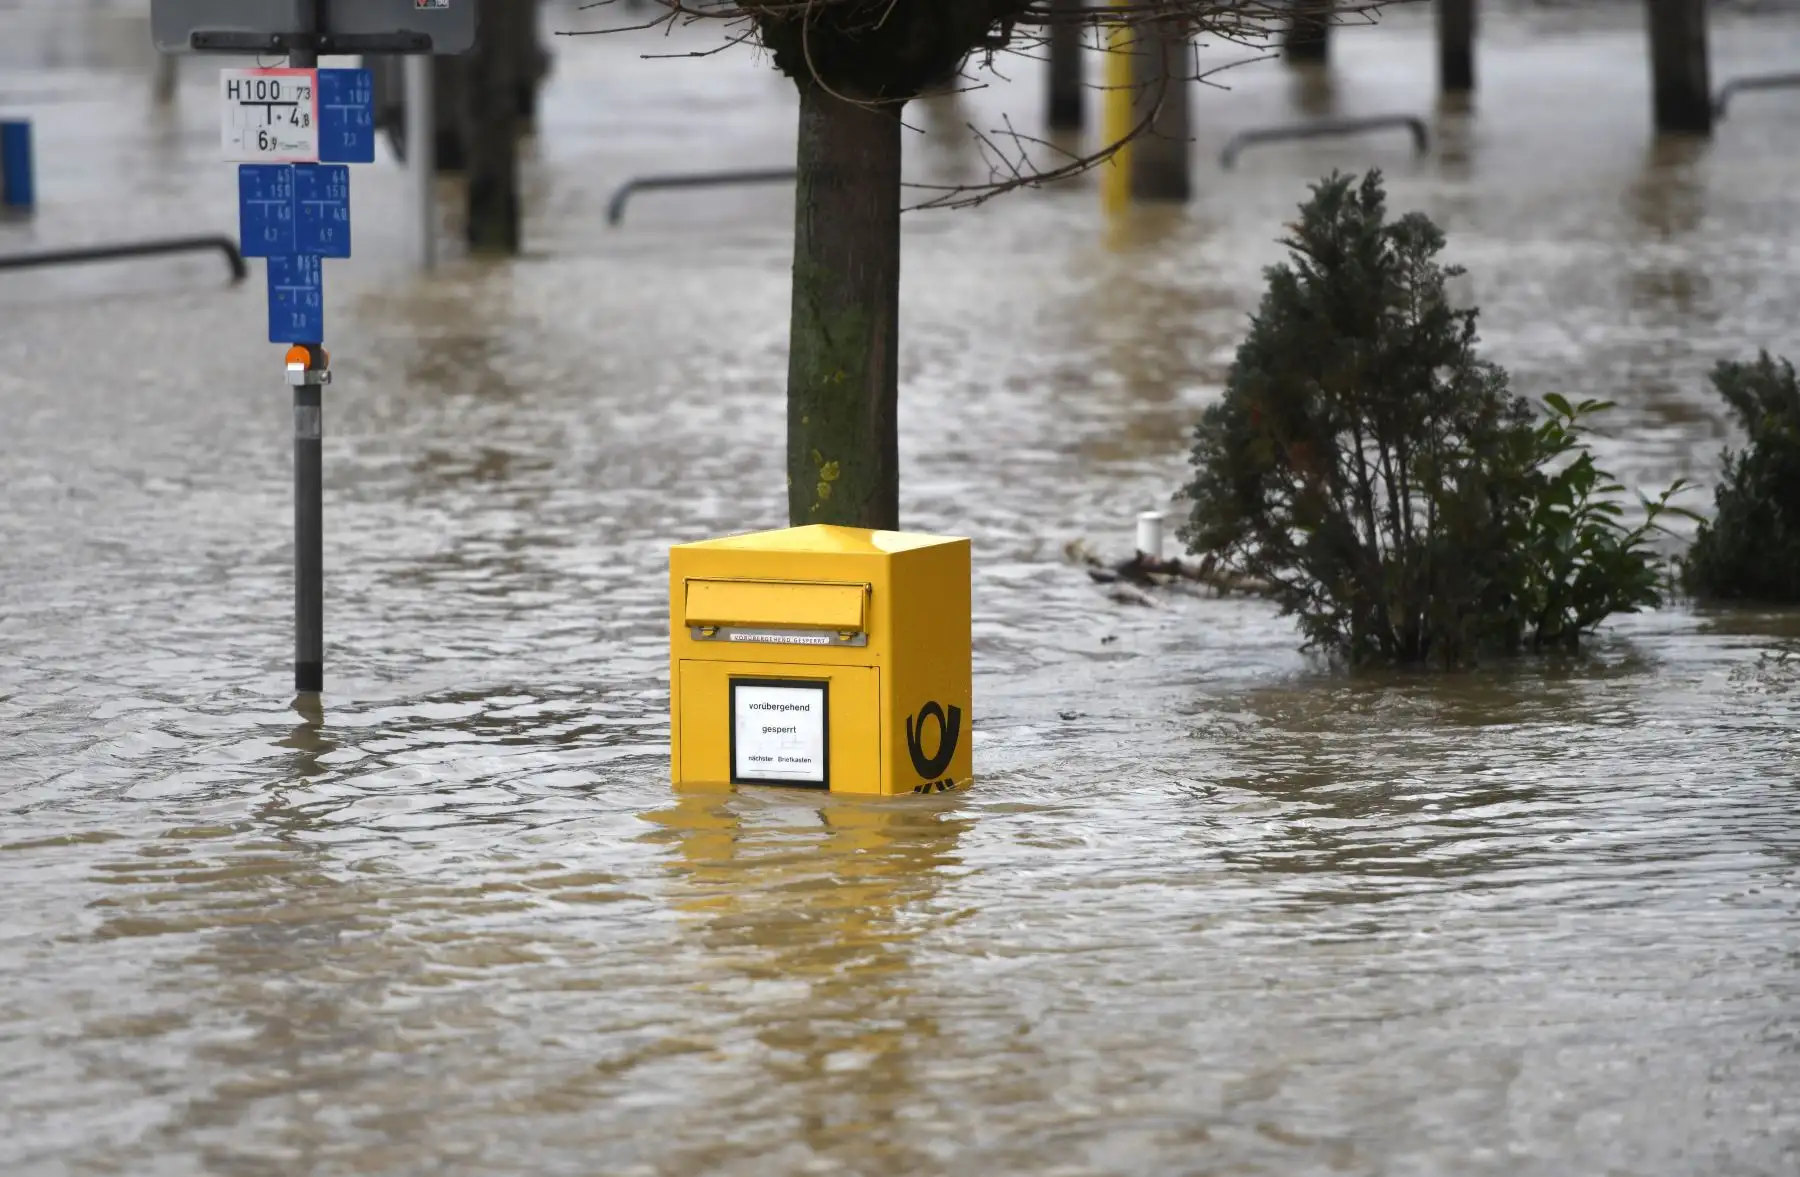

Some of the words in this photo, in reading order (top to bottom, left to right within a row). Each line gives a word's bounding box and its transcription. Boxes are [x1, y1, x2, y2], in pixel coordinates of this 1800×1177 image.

[227, 80, 280, 100] H100
[296, 87, 311, 100] 73
[271, 184, 290, 197] 150
[749, 702, 810, 712] vorübergehend
[762, 725, 796, 734] gesperrt
[777, 756, 812, 764] Briefkasten
